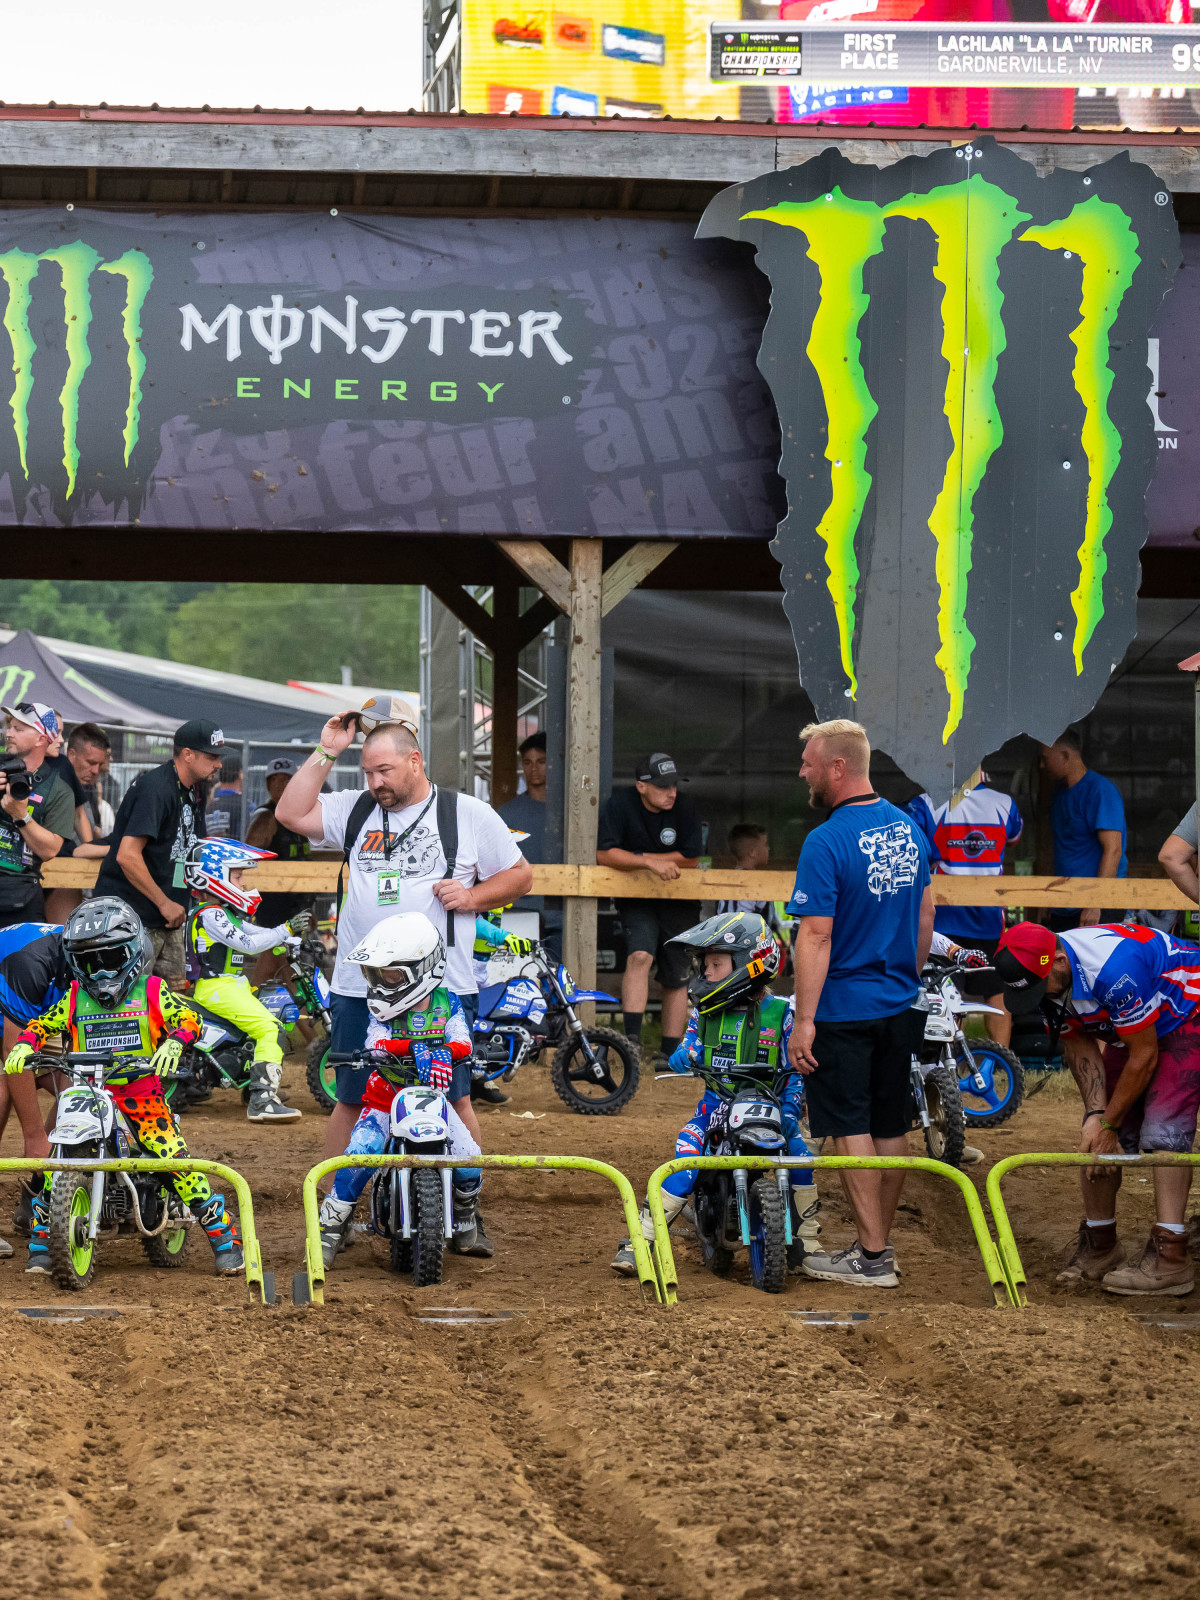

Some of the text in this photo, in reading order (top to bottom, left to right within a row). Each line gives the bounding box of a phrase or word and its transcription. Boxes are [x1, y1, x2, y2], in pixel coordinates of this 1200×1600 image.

[843, 33, 896, 51] FIRST
[938, 35, 1153, 53] LACHLAN "LA LA" TURNER
[724, 55, 798, 65] CHAMPIONSHIP
[840, 52, 899, 70] PLACE
[937, 55, 1102, 75] GARDNERVILLE, NV
[798, 89, 894, 114] RACING
[179, 294, 573, 365] MONSTER
[236, 377, 505, 403] ENERGY
[384, 879, 393, 891] A
[75, 920, 103, 935] FLY
[128, 959, 142, 981] FLY
[753, 961, 761, 976] A
[506, 996, 527, 1007] YAMAHA
[87, 1035, 140, 1049] CHAMPIONSHIP
[414, 1094, 437, 1111] 7
[744, 1104, 774, 1118] 41
